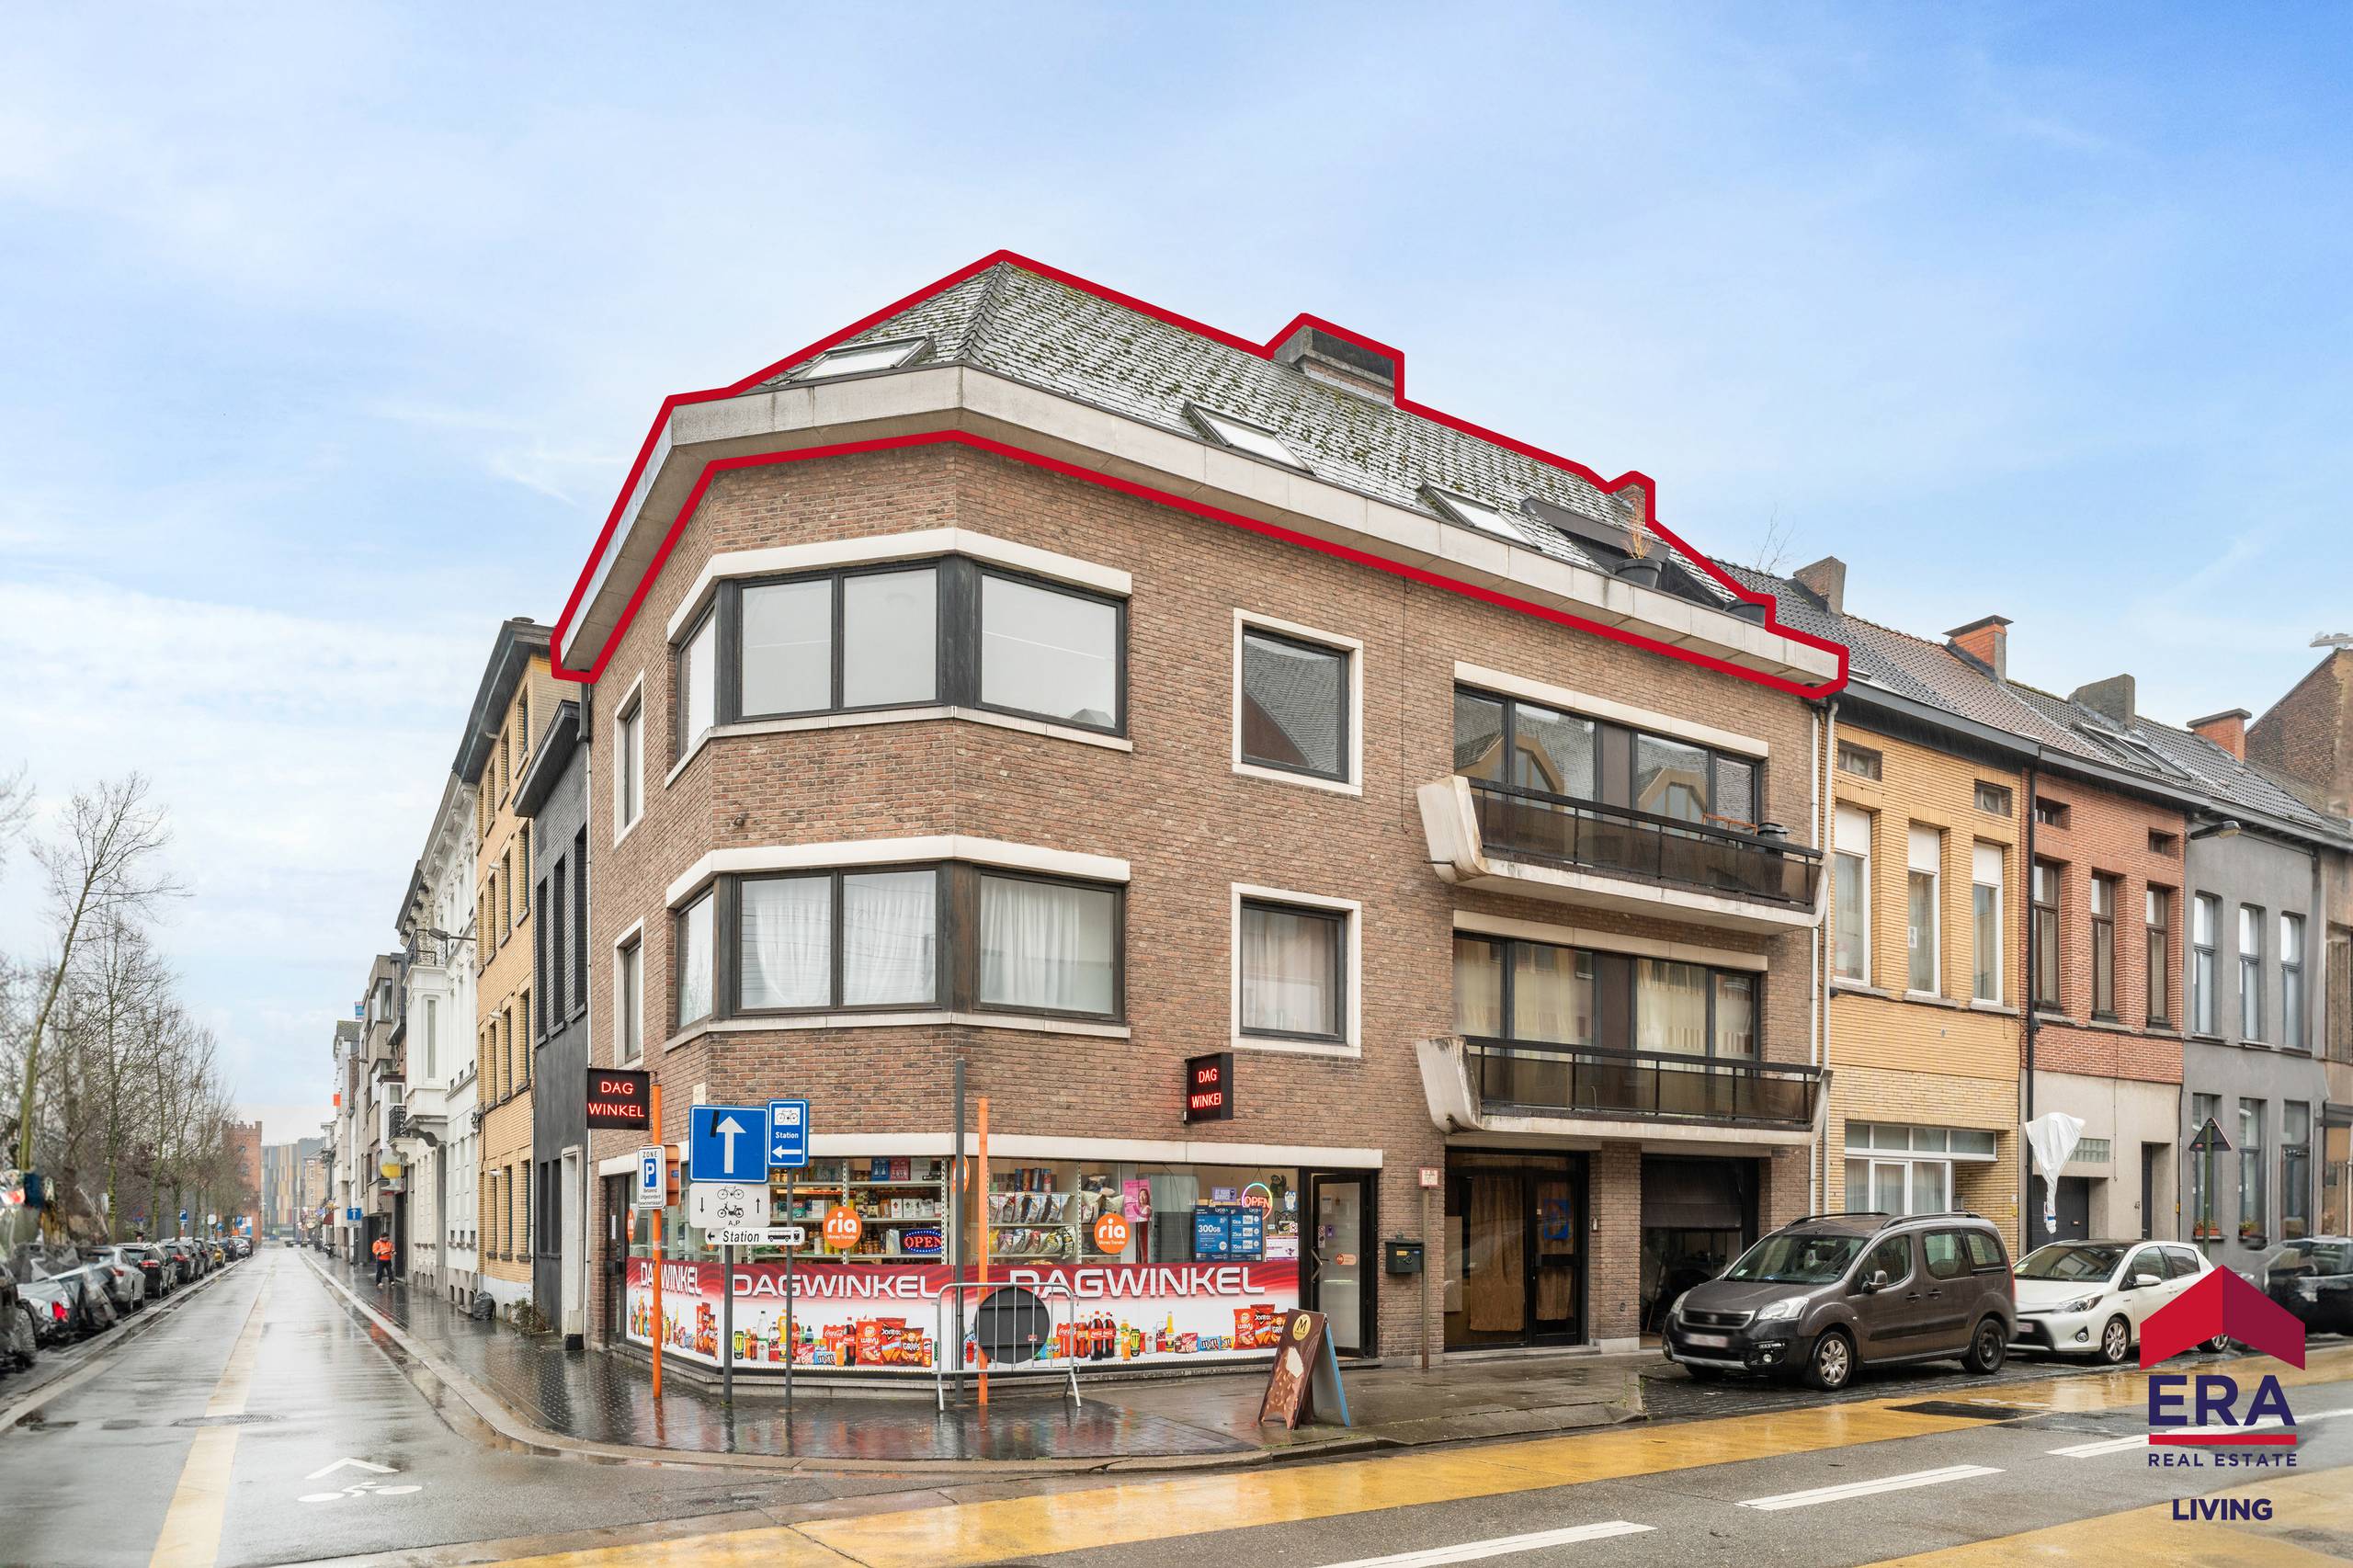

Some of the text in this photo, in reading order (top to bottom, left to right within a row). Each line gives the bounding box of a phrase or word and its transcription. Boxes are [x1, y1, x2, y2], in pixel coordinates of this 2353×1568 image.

[1199, 1068, 1218, 1083] DAG
[601, 1081, 634, 1095] DAG
[588, 1103, 645, 1118] WINKEL
[775, 1131, 800, 1140] Station
[645, 1163, 655, 1184] P
[1245, 1196, 1270, 1209] OPEN
[827, 1211, 858, 1233] ria
[1098, 1218, 1126, 1239] ria
[1198, 1224, 1222, 1233] 300GB
[722, 1230, 760, 1243] Station
[904, 1236, 942, 1248] OPEN
[641, 1262, 703, 1296] DAWINKEL
[733, 1274, 939, 1298] DAGWINKEL
[1010, 1267, 1266, 1299] DAGWINKEL
